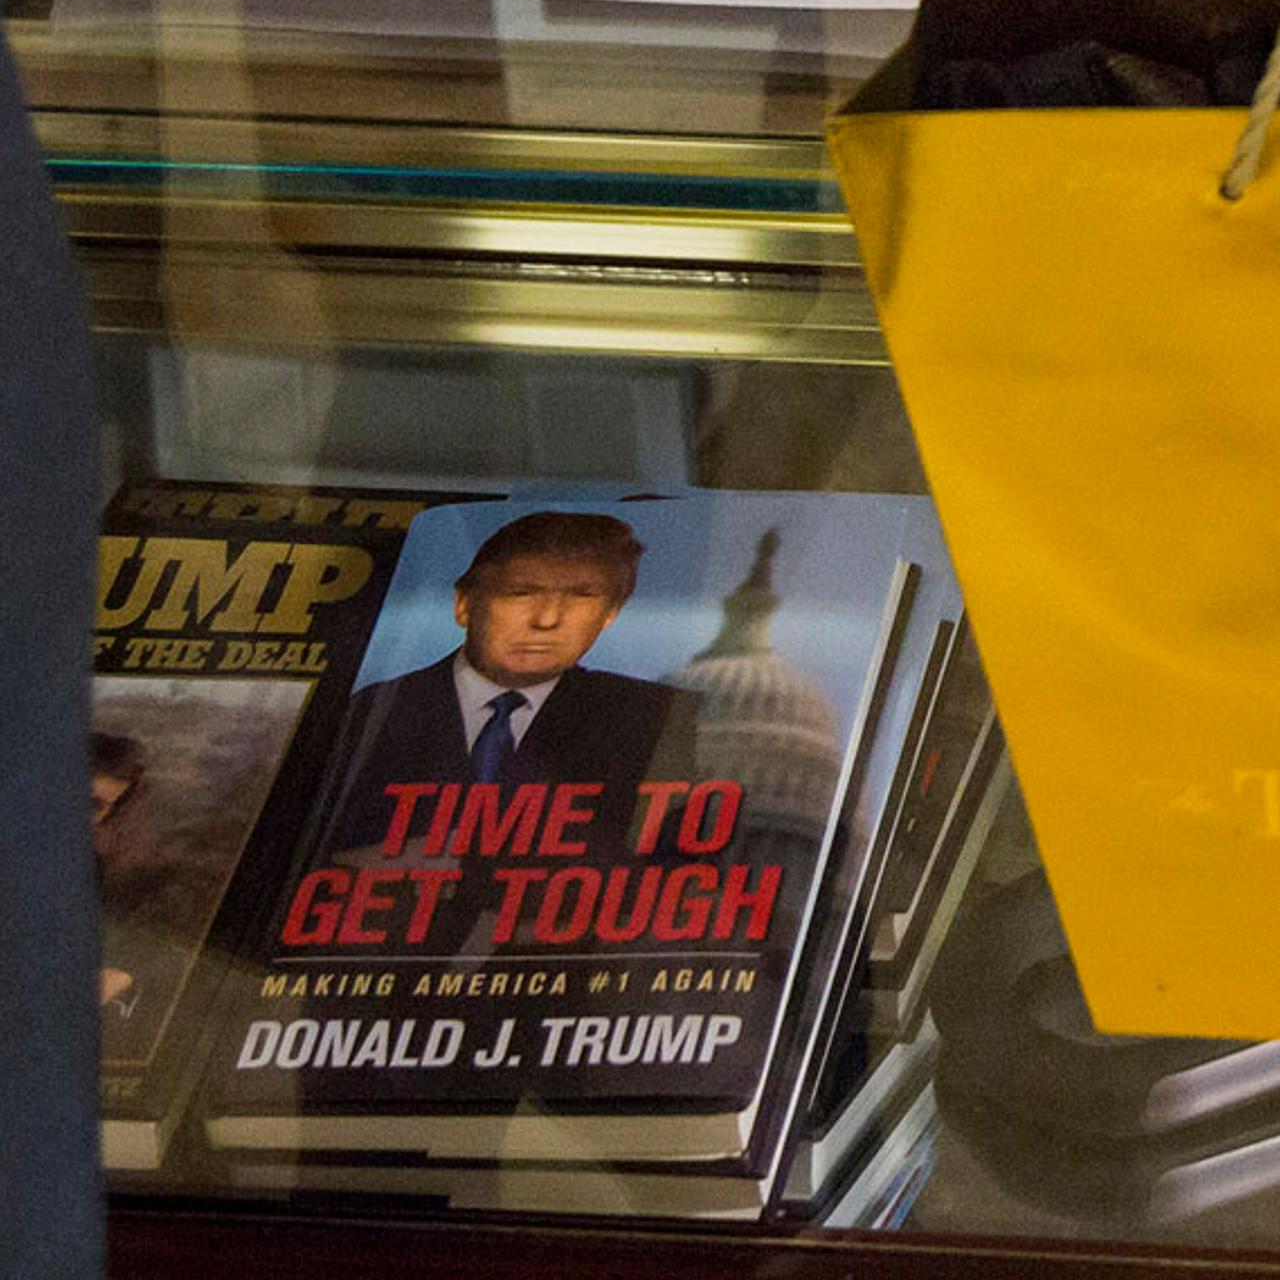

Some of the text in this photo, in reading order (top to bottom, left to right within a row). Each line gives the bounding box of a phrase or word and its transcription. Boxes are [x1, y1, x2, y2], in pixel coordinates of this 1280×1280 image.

[94, 535, 374, 634] UMP
[123, 637, 215, 670] THE
[218, 641, 328, 673] DEAL
[379, 779, 746, 858] TIME TO
[281, 864, 784, 946] GET TOUGH
[261, 969, 756, 997] MAKING AMERICA #1 AGAIN
[236, 1014, 743, 1070] DONALD J. TRUMP
